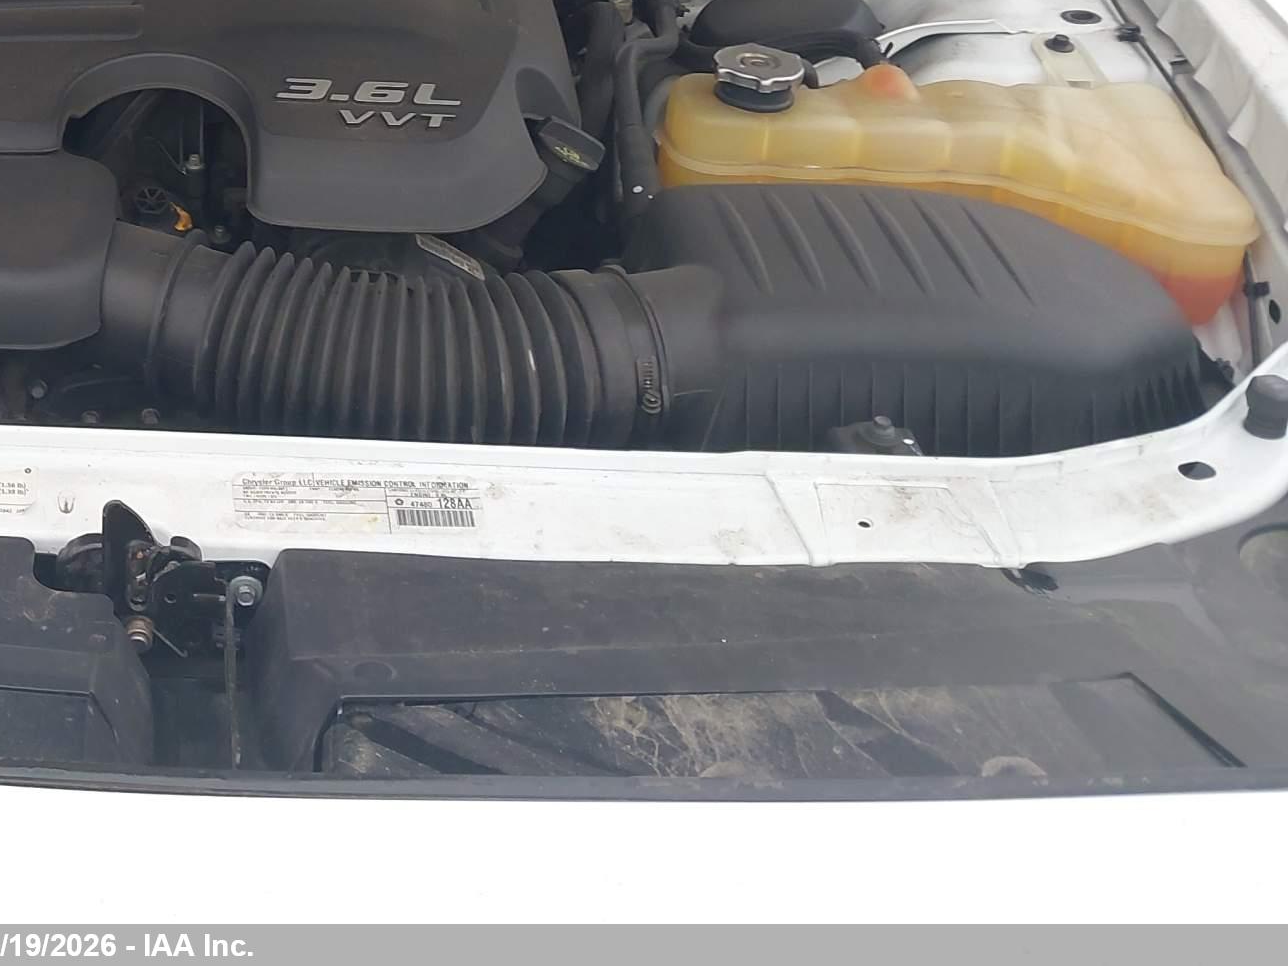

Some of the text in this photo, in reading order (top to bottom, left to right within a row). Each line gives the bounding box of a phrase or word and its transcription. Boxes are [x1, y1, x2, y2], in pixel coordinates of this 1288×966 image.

[276, 78, 461, 106] 3.6L
[339, 109, 457, 128] VVT
[242, 478, 273, 487] Chrysler
[274, 479, 297, 487] Group
[315, 479, 345, 487] VEHICLE
[437, 498, 473, 509] 128AA
